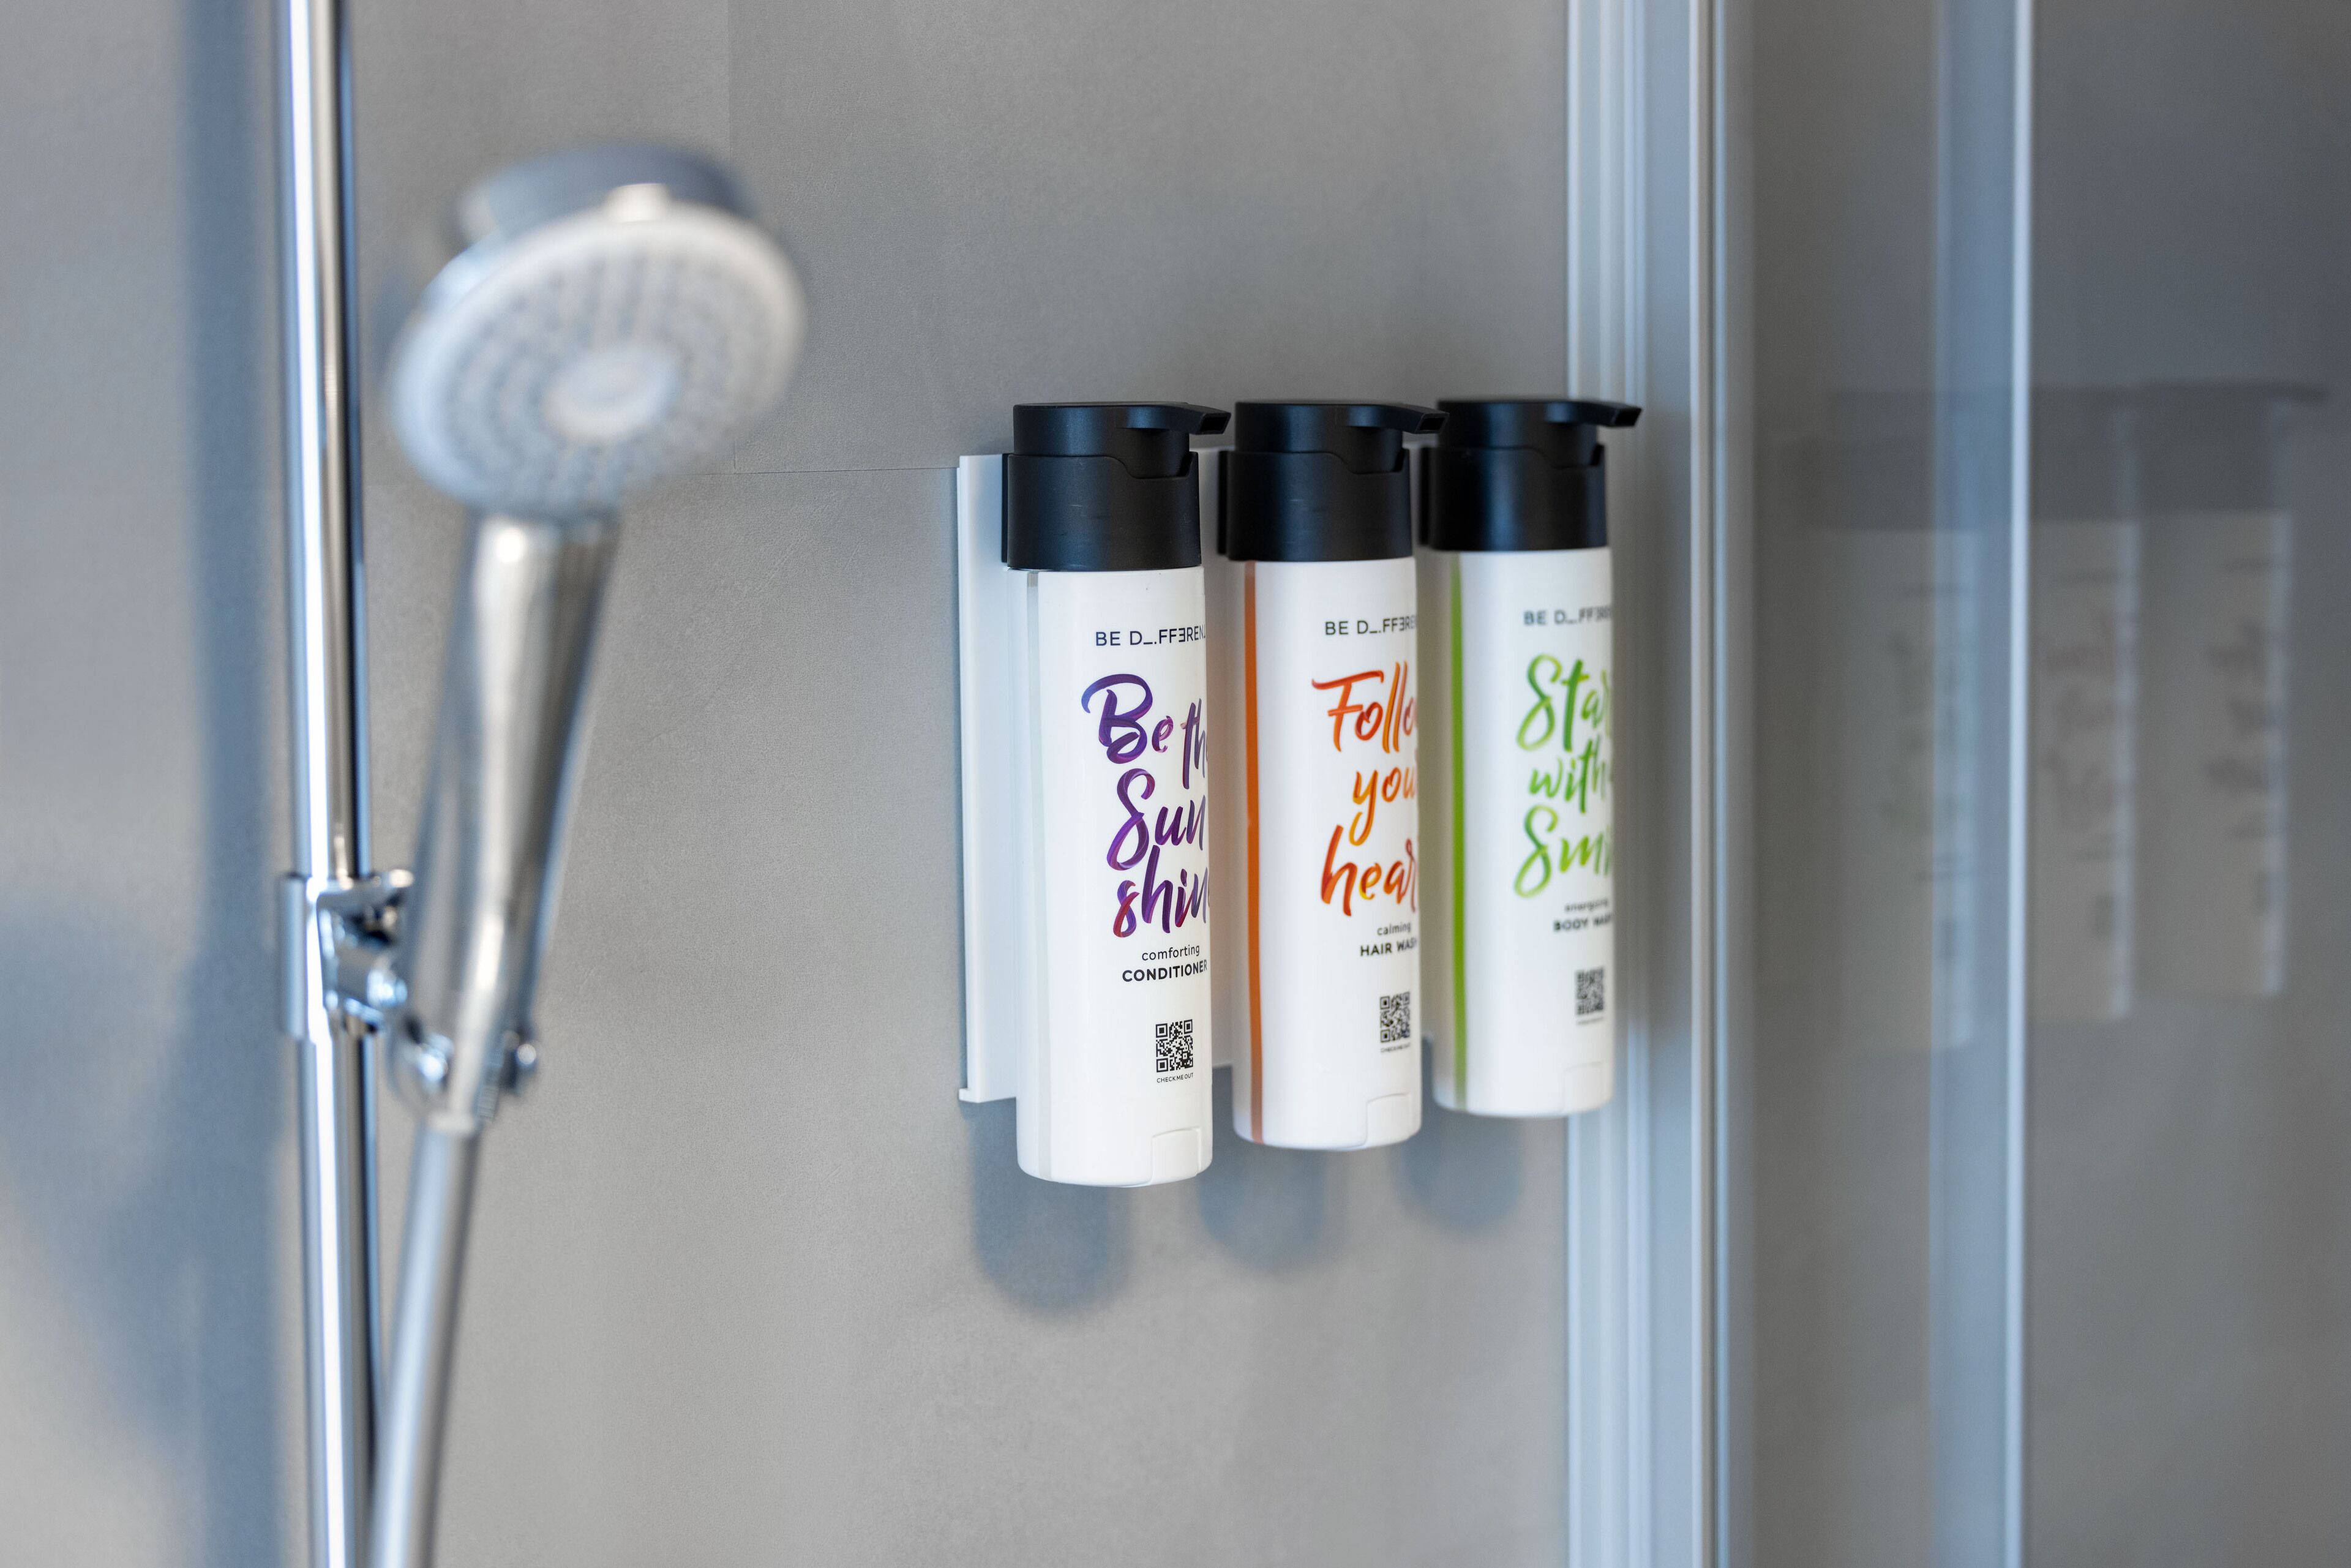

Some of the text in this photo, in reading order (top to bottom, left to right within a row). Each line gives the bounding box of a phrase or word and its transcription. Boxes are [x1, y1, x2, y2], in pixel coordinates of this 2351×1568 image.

[1096, 631, 1120, 646] BE
[1325, 621, 1349, 635] BE
[1523, 610, 1547, 625] BE
[1081, 673, 1208, 790] Be th
[1311, 659, 1417, 754] Follo
[1349, 767, 1417, 846] you
[1529, 735, 1607, 814] with
[1106, 768, 1206, 871] Sun
[1514, 805, 1614, 899] Smi
[1112, 845, 1210, 938] shin
[1321, 825, 1417, 917] hear
[1142, 944, 1200, 961] comforting
[1360, 937, 1417, 957] HAIR WAS
[1377, 922, 1411, 936] calming
[1122, 959, 1207, 982] CONDITIONER
